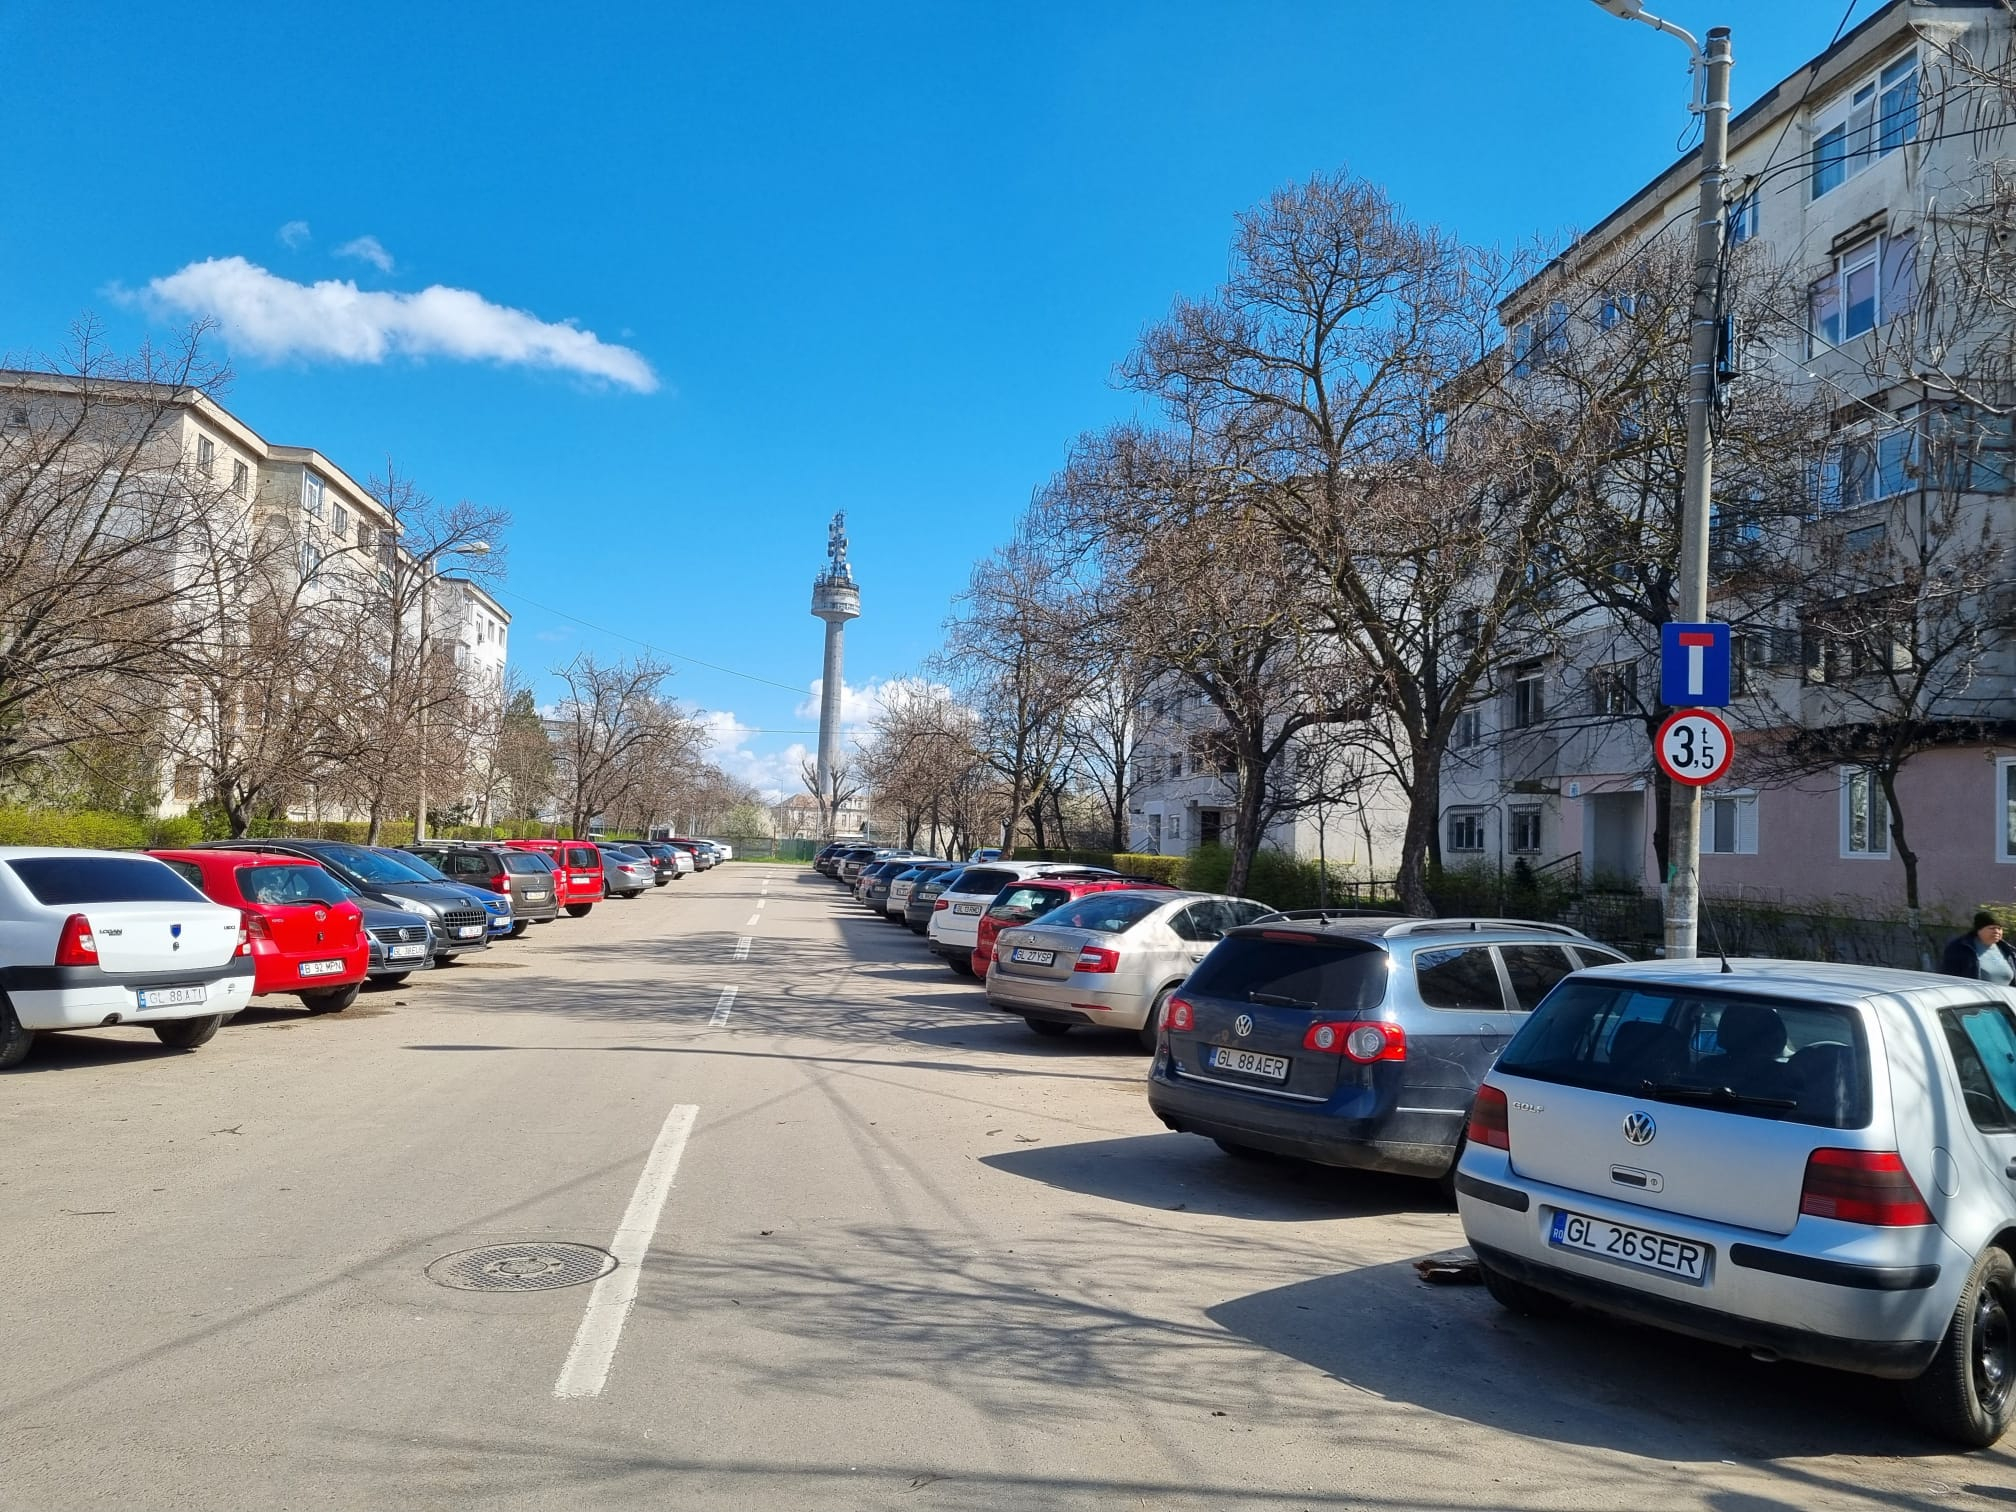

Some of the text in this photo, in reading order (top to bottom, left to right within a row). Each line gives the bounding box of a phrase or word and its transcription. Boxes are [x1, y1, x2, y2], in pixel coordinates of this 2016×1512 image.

[1217, 1050, 1233, 1067] GL
[1512, 1100, 1545, 1113] GOLF
[1553, 1228, 1564, 1239] RO
[1567, 1218, 1596, 1248] GL
